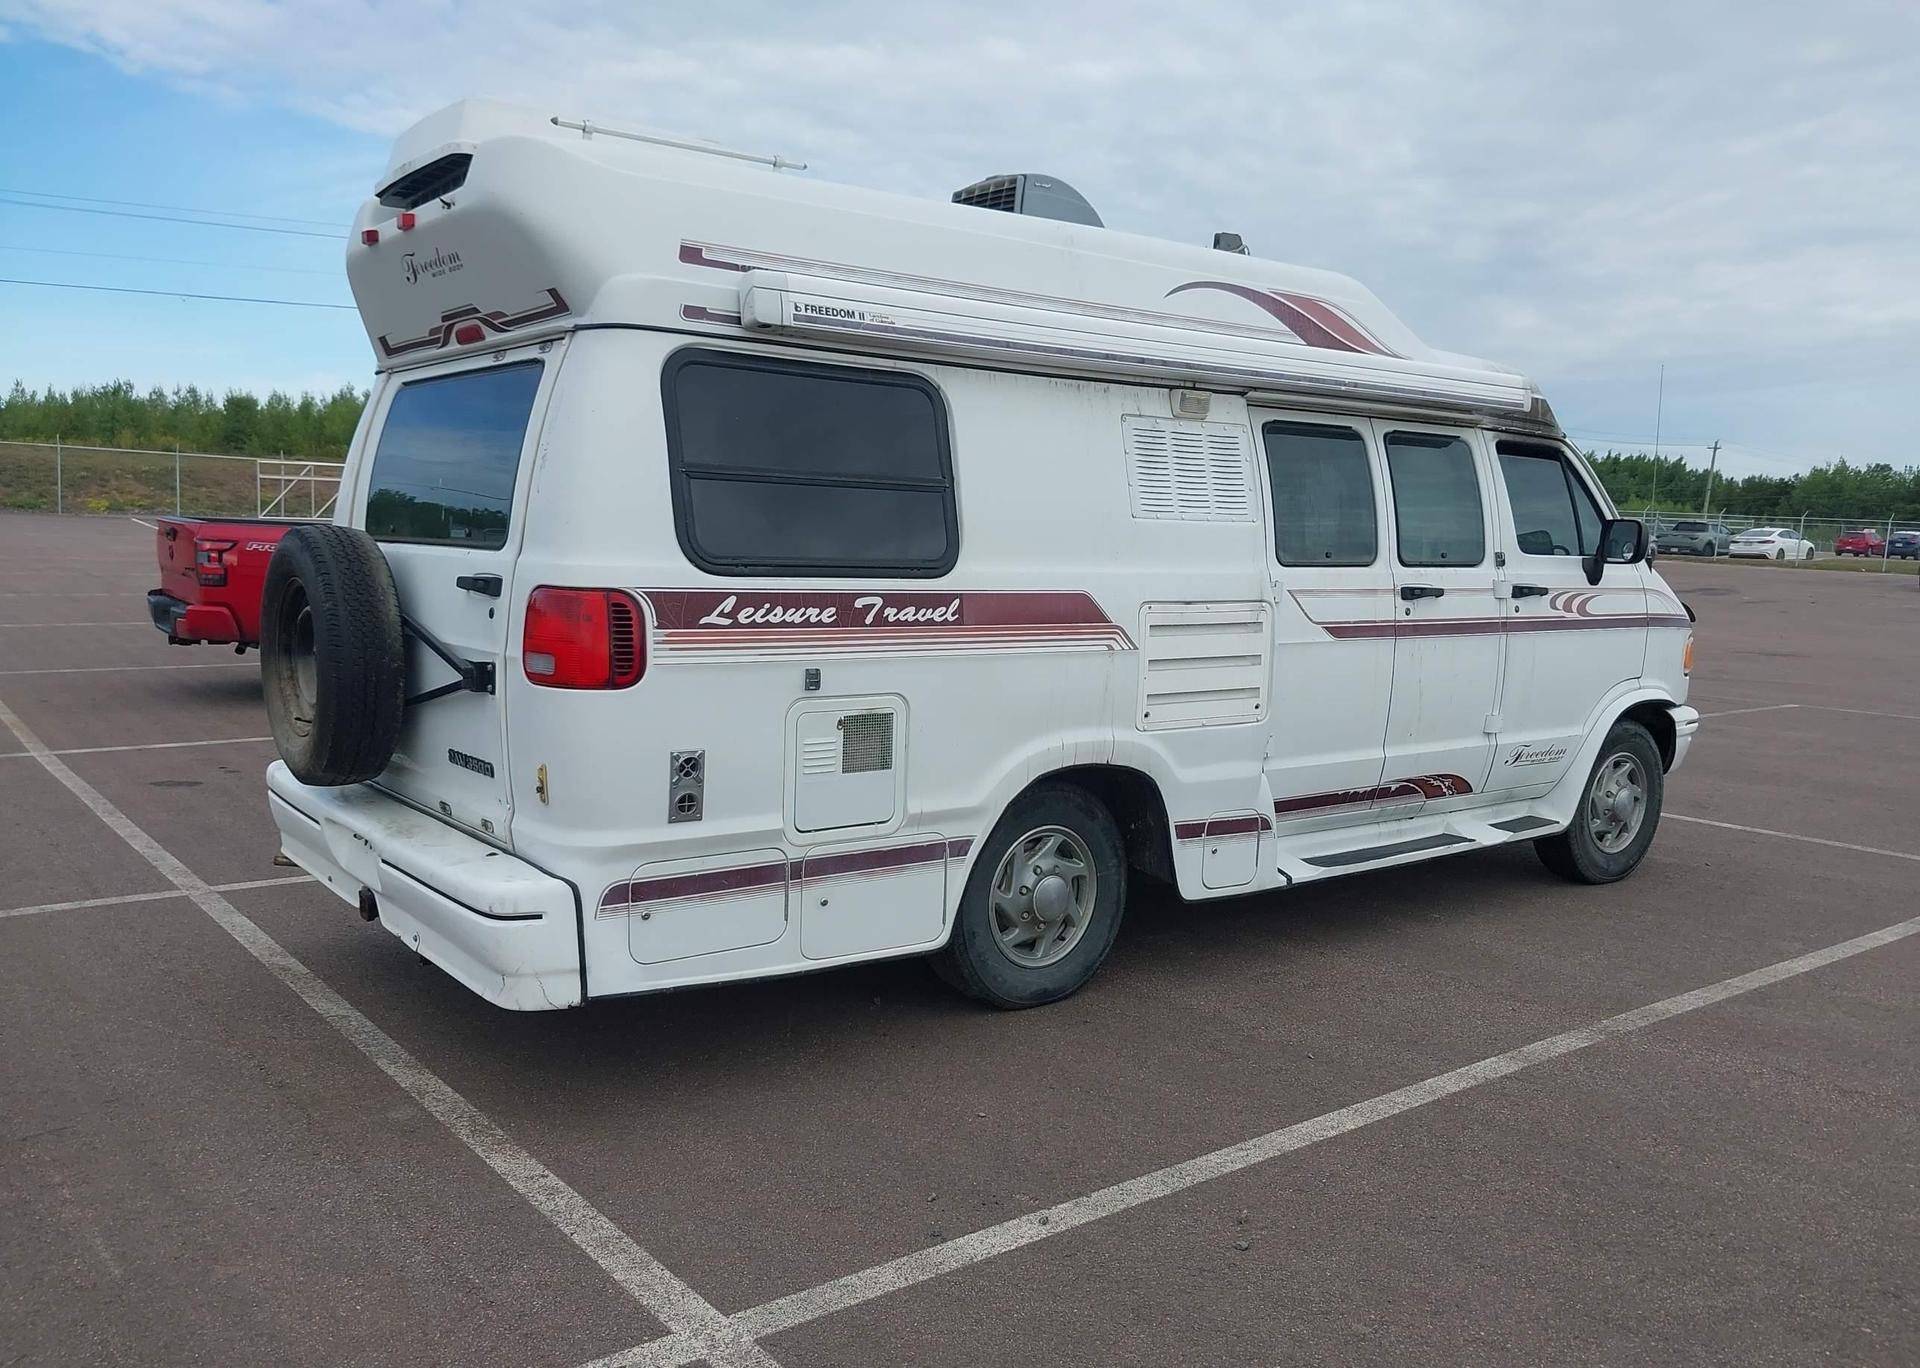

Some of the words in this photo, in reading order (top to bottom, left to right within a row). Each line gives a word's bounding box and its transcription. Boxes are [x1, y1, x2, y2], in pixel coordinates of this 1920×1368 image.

[401, 247, 461, 285] Freedom
[804, 303, 856, 319] FREEDOM
[699, 594, 837, 626] Leisure
[854, 595, 961, 625] Travel
[1503, 743, 1568, 767] Freedom
